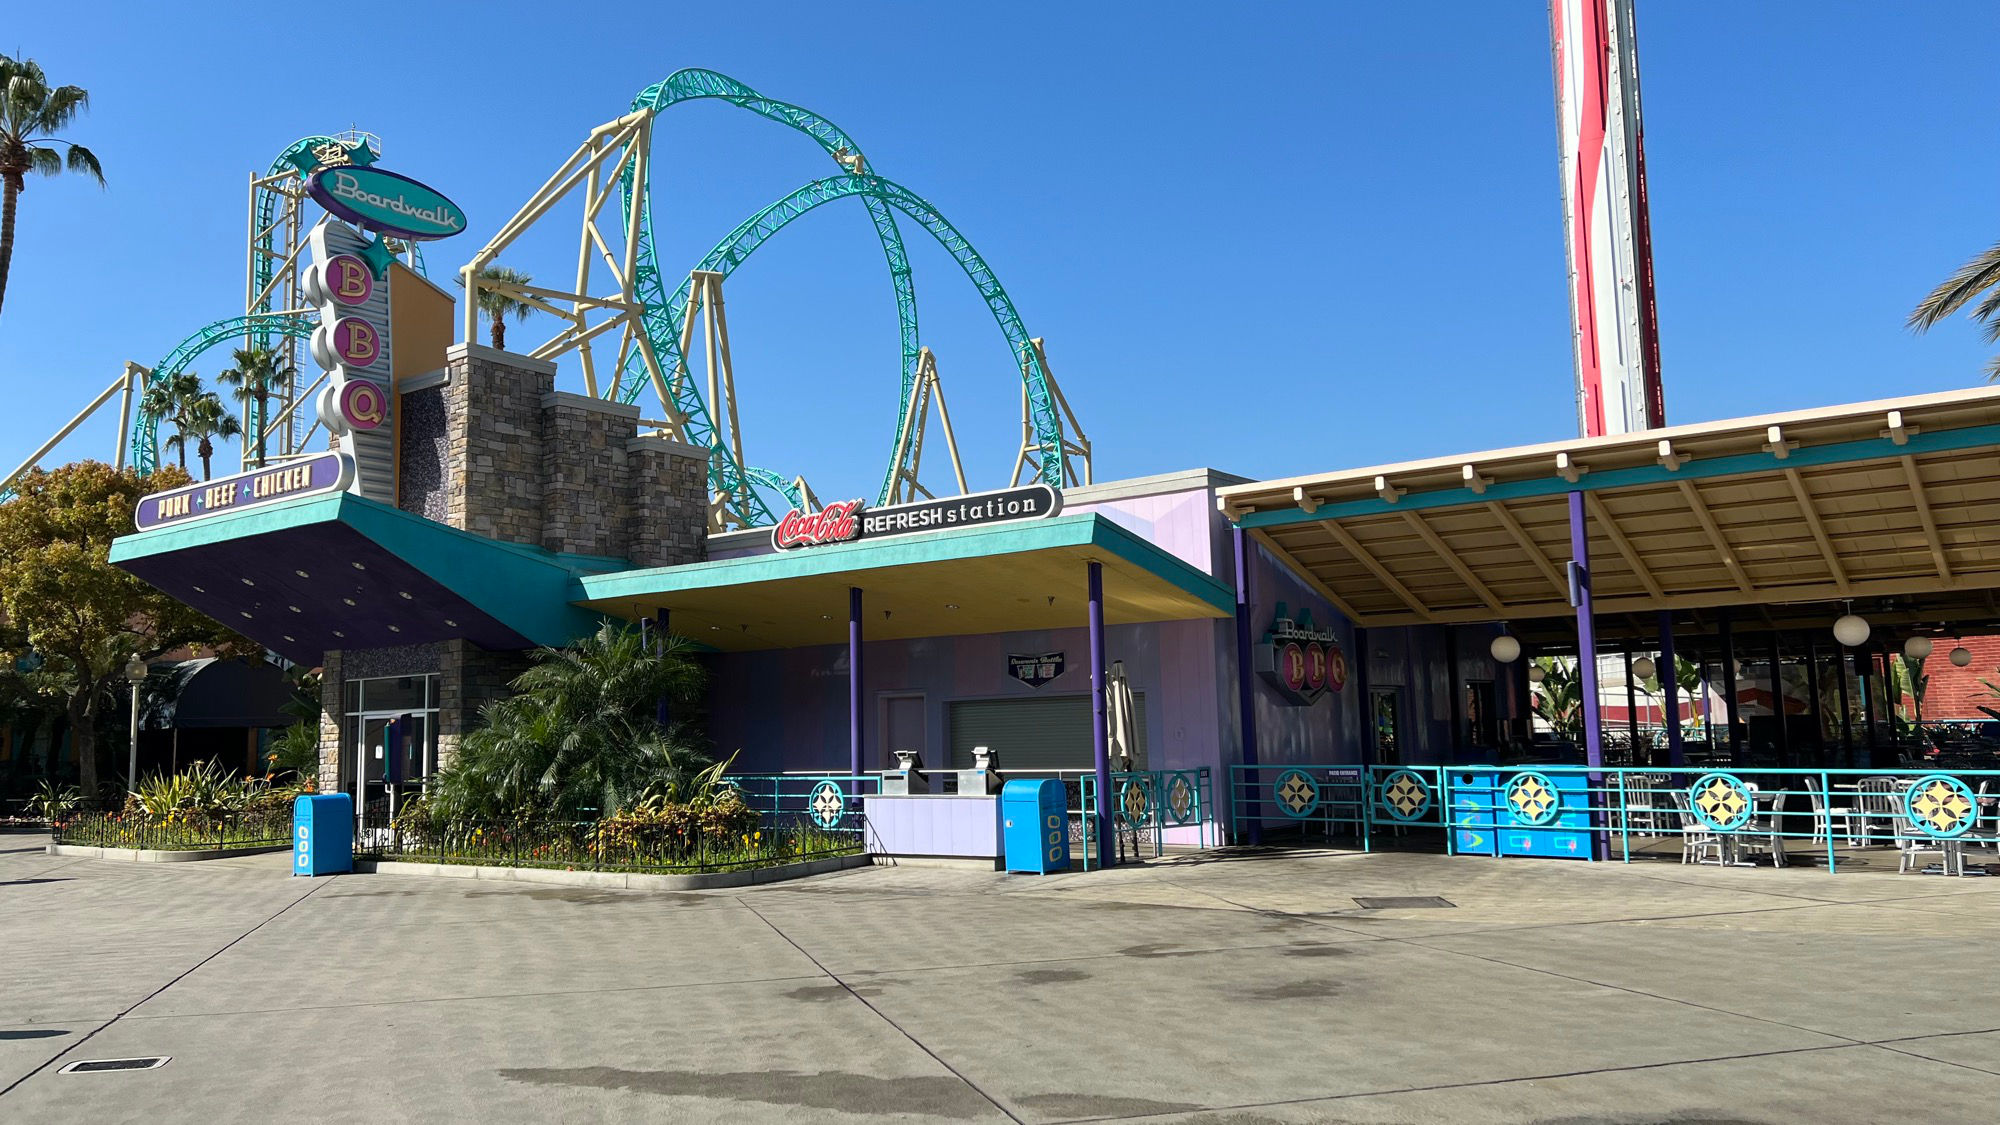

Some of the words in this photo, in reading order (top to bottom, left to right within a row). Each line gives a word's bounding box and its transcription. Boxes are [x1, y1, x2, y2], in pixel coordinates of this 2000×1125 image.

[333, 170, 459, 229] Boardwalk
[338, 259, 382, 424] BBQ
[158, 494, 192, 520] PORK
[205, 483, 238, 510] BEEF
[253, 464, 313, 498] CHICKEN
[778, 498, 863, 547] Coca-Cola
[863, 507, 943, 533] REFRESH
[947, 497, 1037, 523] station
[1274, 618, 1338, 642] Boardwalk
[1290, 650, 1348, 683] BBQ
